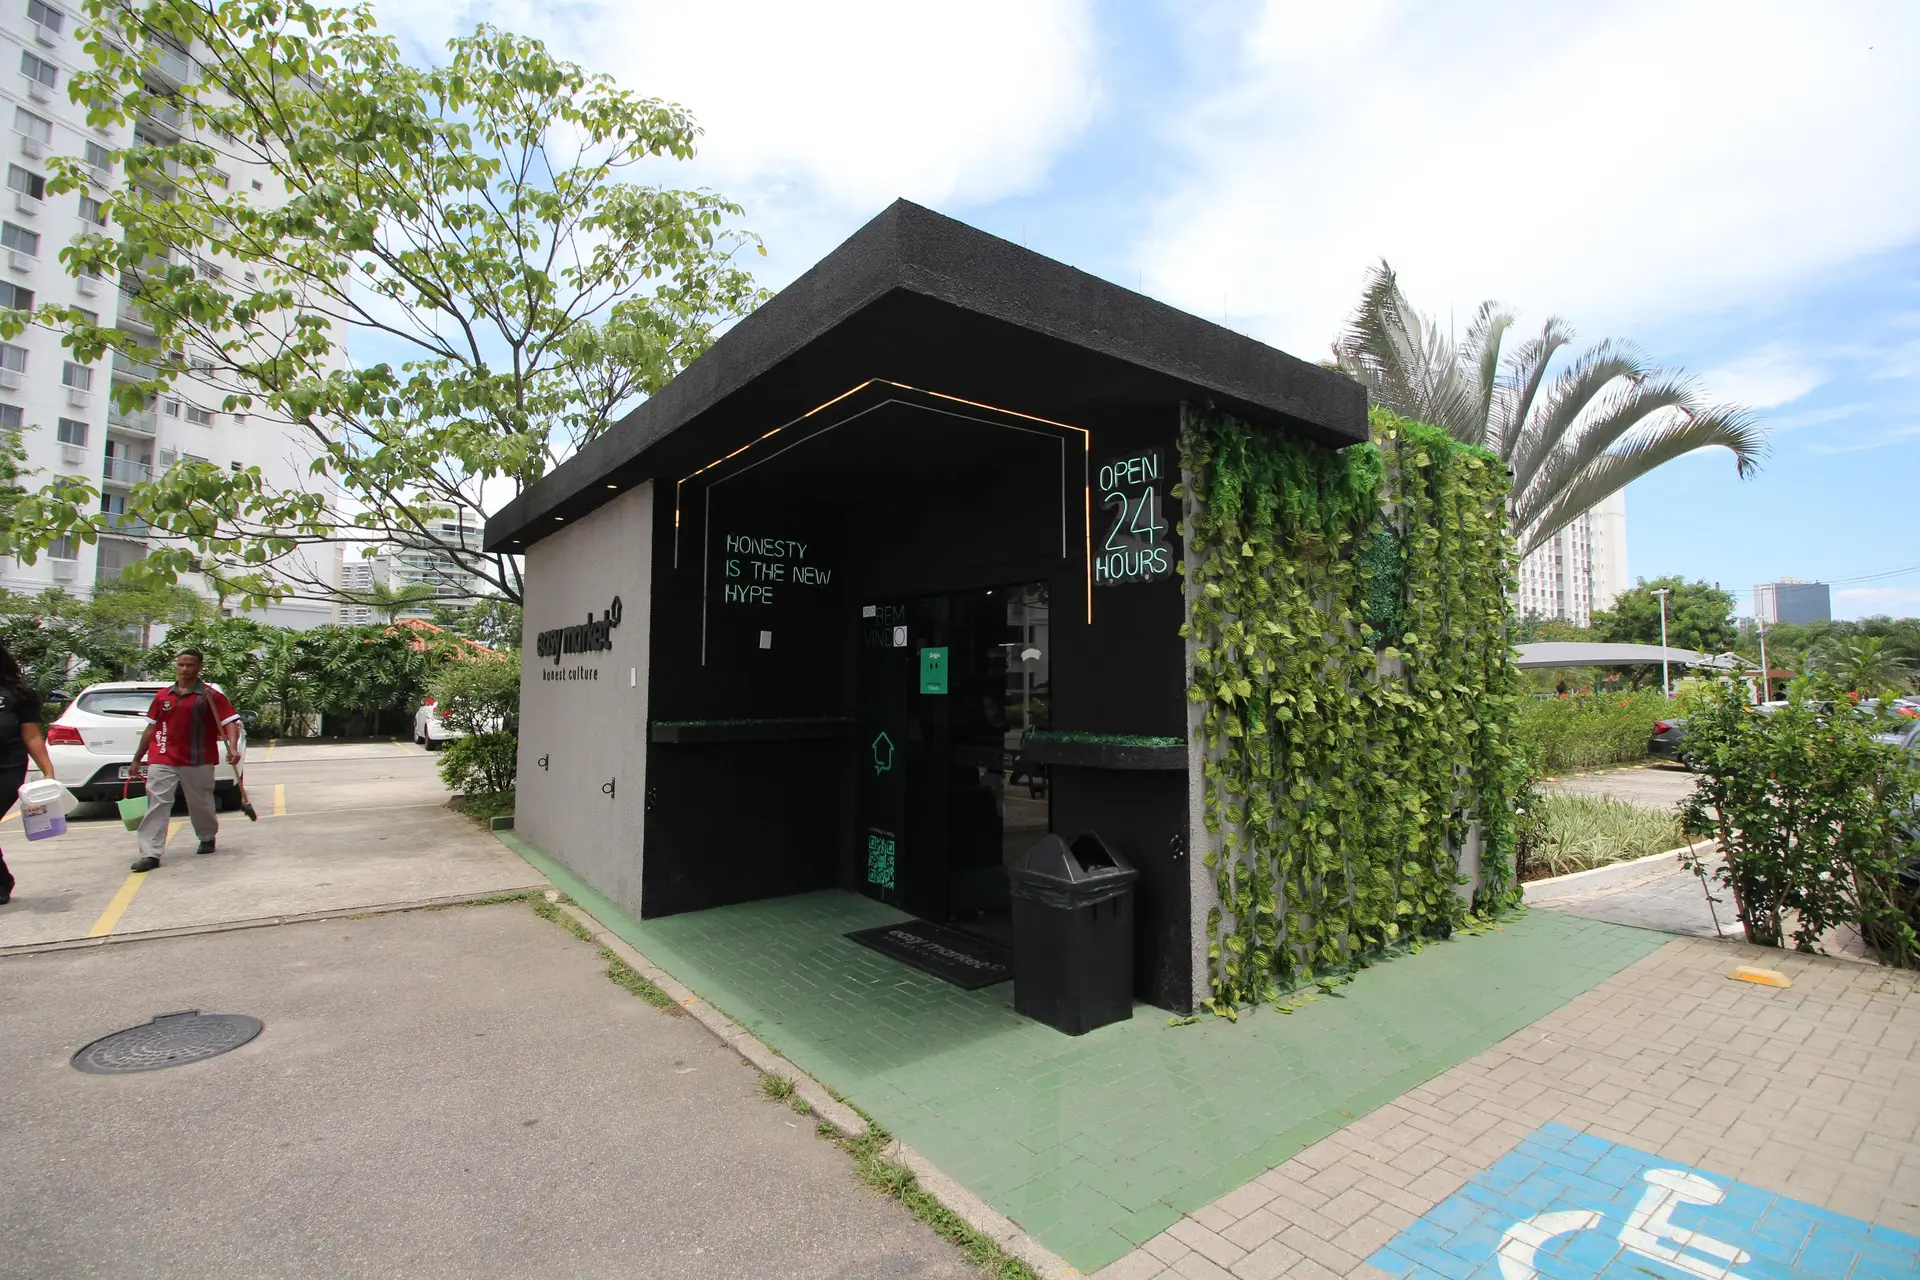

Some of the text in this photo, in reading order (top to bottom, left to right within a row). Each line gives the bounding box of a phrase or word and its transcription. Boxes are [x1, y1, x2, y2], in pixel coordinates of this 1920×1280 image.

[1099, 453, 1157, 491] OPEN
[1104, 486, 1164, 551] 24
[726, 533, 808, 560] HONESTY
[725, 559, 832, 585] IS THE NEW
[1095, 547, 1168, 582] HOURS
[725, 584, 774, 604] HYPE
[875, 604, 905, 626] BEM
[537, 609, 613, 665] easy market
[542, 666, 598, 681] honest culture
[888, 930, 930, 945] easy
[922, 942, 991, 969] market
